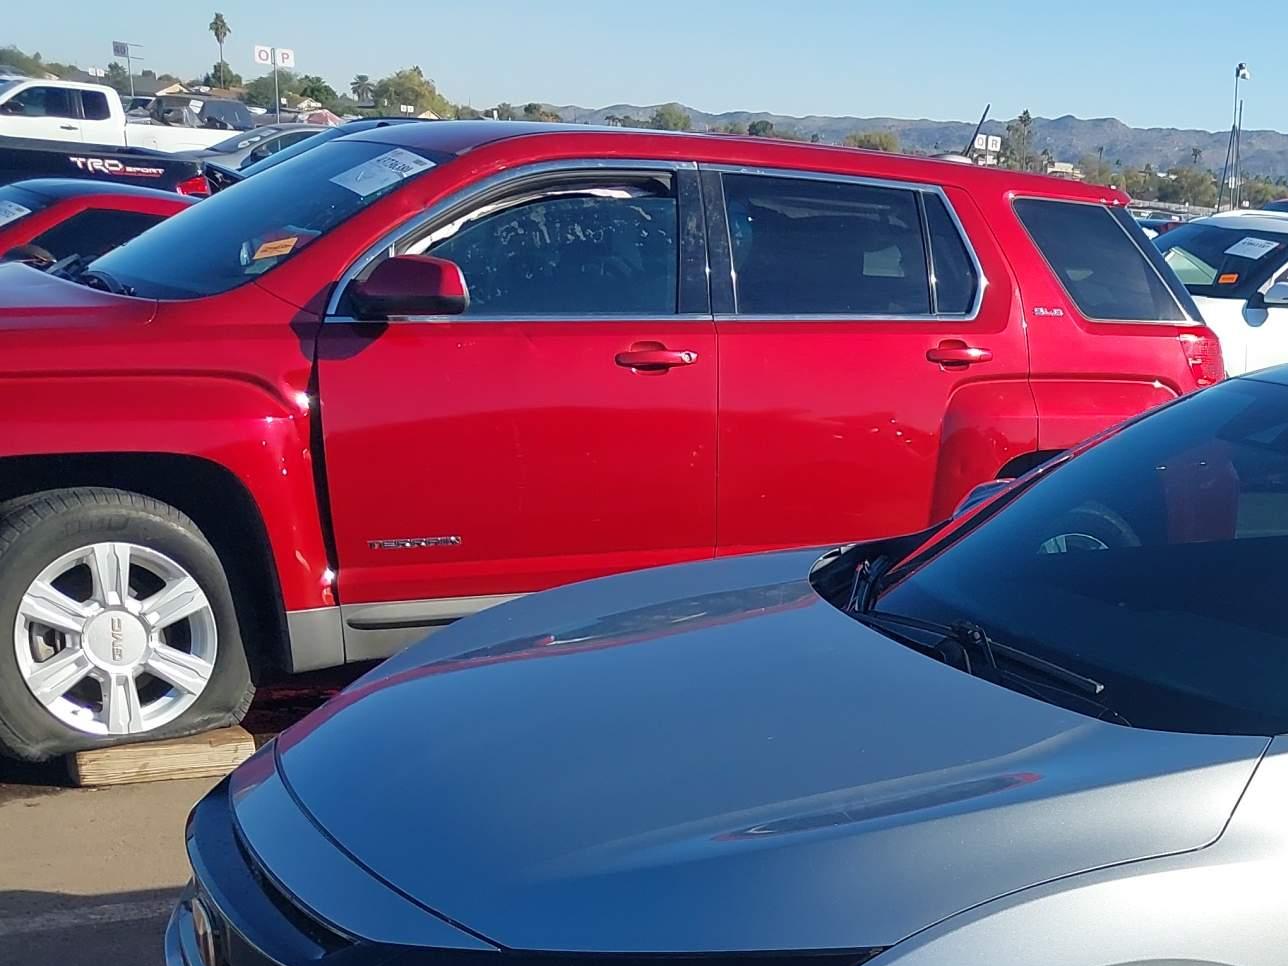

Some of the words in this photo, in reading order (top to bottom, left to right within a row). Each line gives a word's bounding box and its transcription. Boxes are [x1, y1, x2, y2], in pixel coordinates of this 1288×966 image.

[280, 52, 290, 64] P
[69, 156, 124, 174] TRD
[367, 536, 462, 550] TERRAIN
[111, 617, 123, 661] GMC
